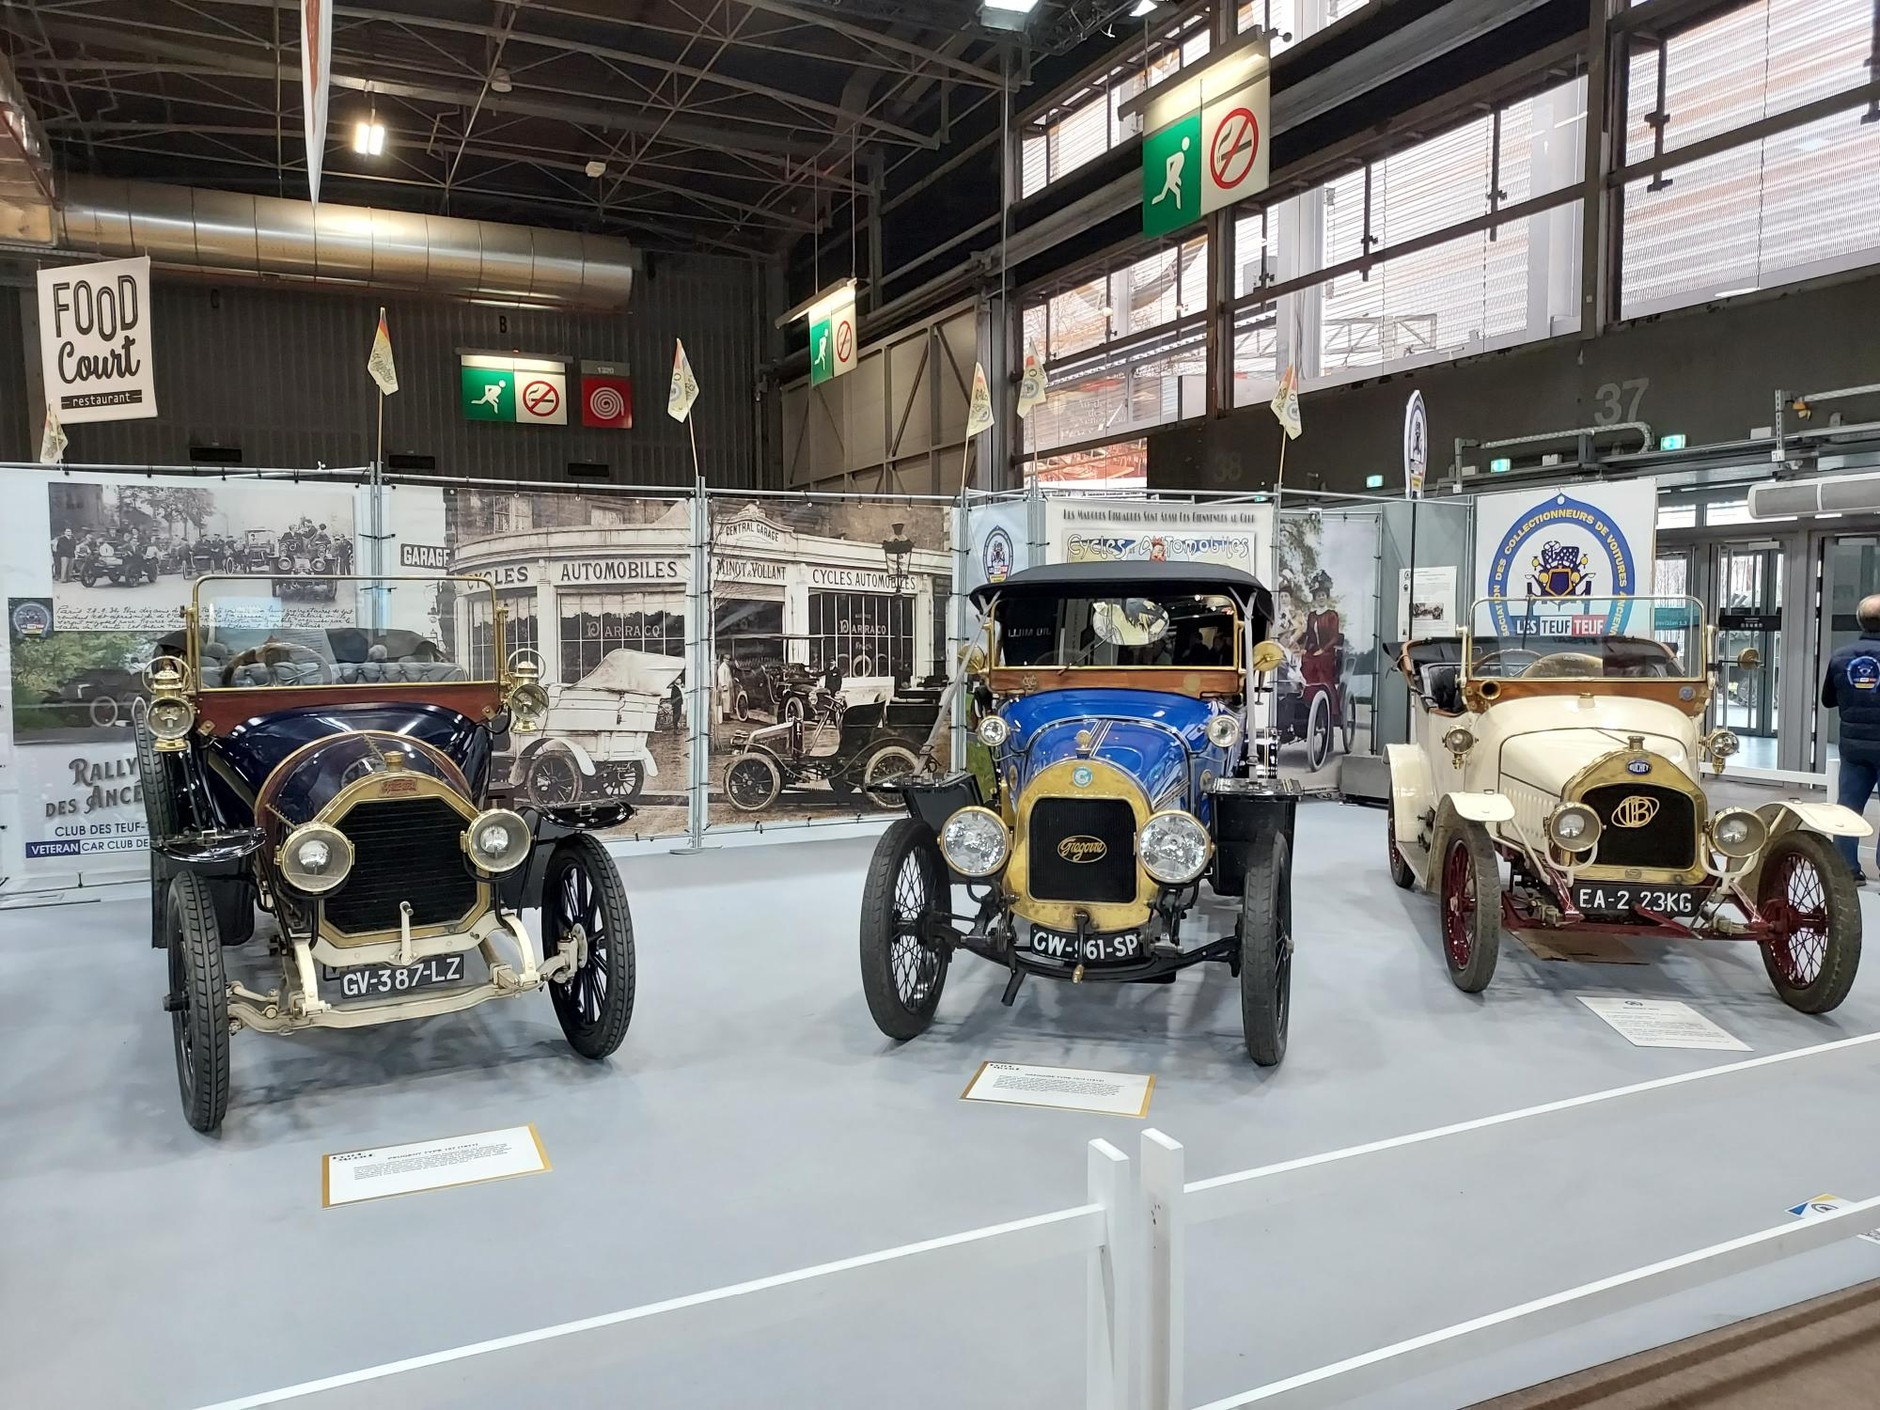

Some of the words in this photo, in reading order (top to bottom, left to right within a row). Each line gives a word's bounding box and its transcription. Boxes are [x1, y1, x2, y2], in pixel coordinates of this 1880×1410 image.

[52, 274, 139, 341] FOOD
[500, 315, 508, 333] B
[58, 335, 141, 384] Court
[72, 392, 131, 407] restaurant
[1594, 377, 1649, 426] 37
[725, 522, 754, 536] CENTRAL
[756, 523, 779, 542] GARAGE
[403, 546, 450, 567] GARAGE
[1504, 508, 1595, 555] COLLECTIONNEURS
[1594, 520, 1610, 537] DE
[1606, 534, 1628, 588] VOITURES
[561, 561, 678, 581] AUTOMOBILES
[1494, 558, 1507, 581] DES
[1516, 619, 1537, 634] LES
[1541, 619, 1571, 634] TEUF
[1573, 619, 1604, 634] TEUF
[68, 757, 138, 787] RALLY
[45, 799, 77, 817] DES
[55, 826, 86, 837] CLUB
[90, 823, 112, 834] DES
[31, 843, 79, 855] VETERAN
[81, 841, 104, 851] CAR
[107, 840, 133, 850] CLUB
[343, 957, 461, 995] GV-387-LZ
